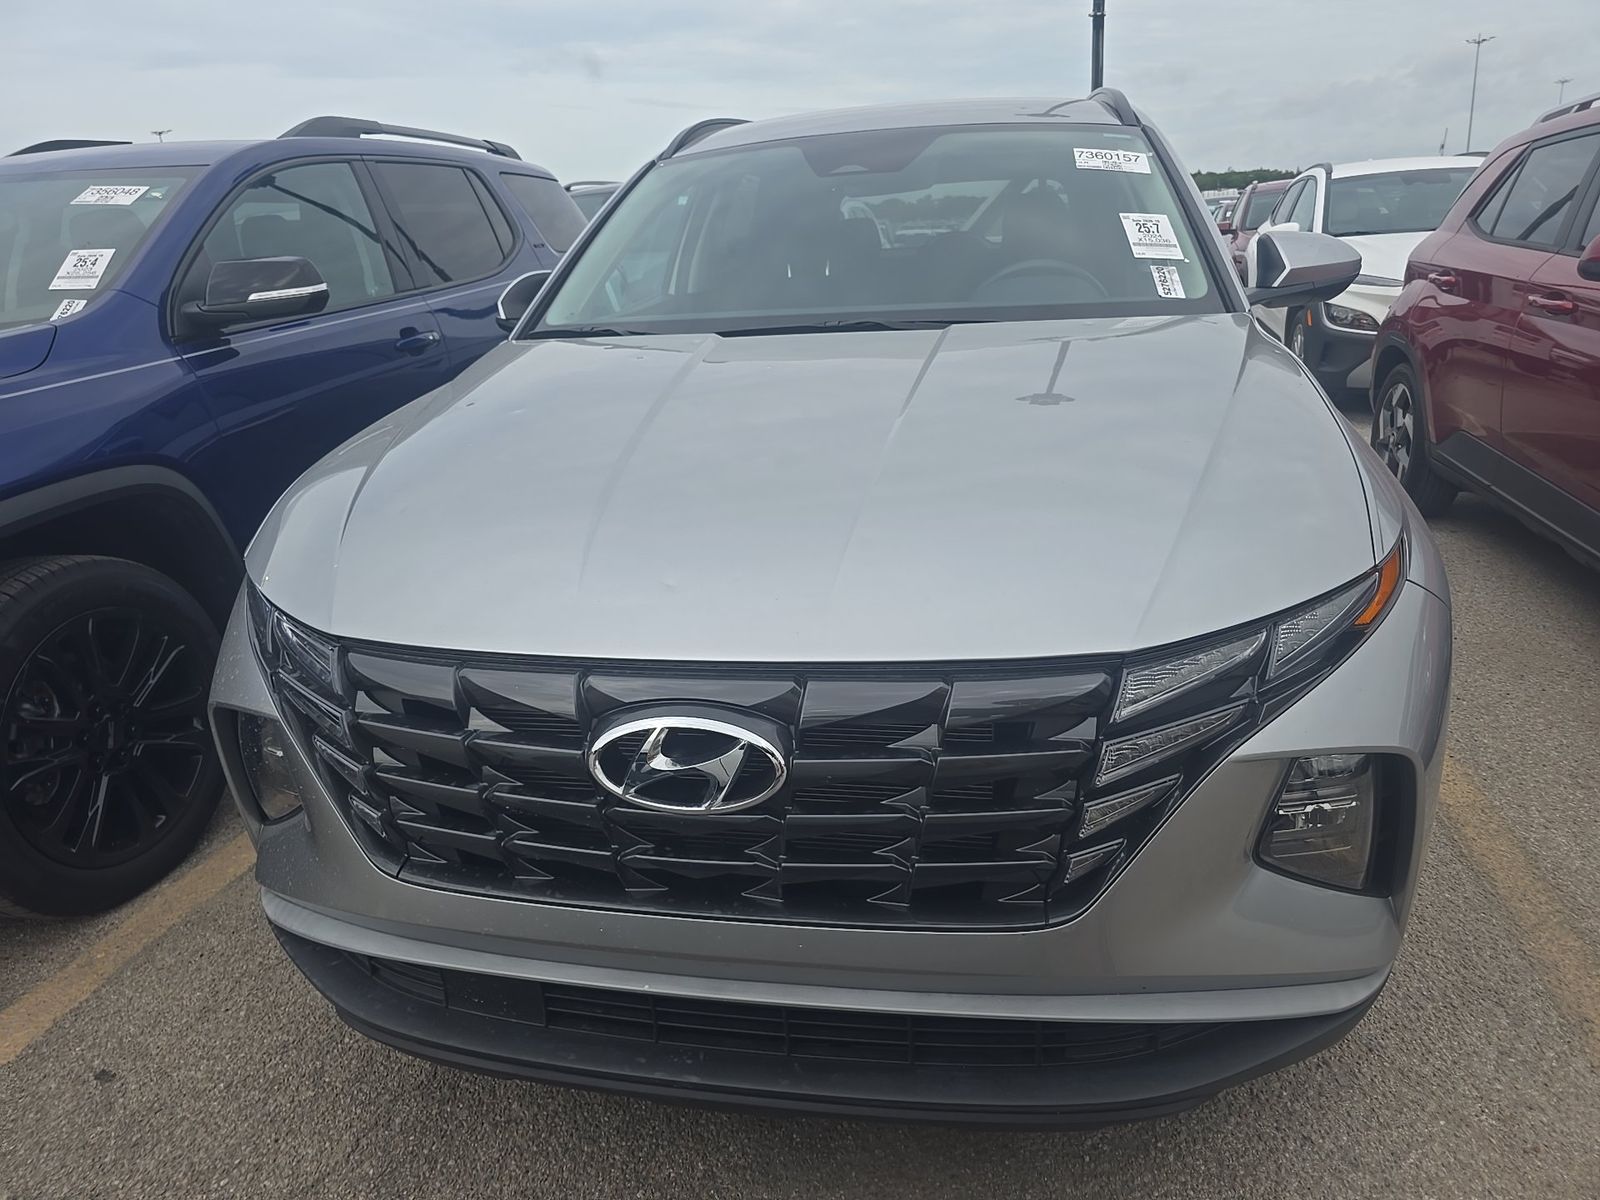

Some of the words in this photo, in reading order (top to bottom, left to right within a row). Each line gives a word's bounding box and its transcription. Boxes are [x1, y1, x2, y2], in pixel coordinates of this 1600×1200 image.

[1076, 151, 1140, 163] 7360157
[1135, 222, 1160, 234] 25:7
[73, 258, 99, 268] 25:4
[1156, 266, 1172, 296] 5276220
